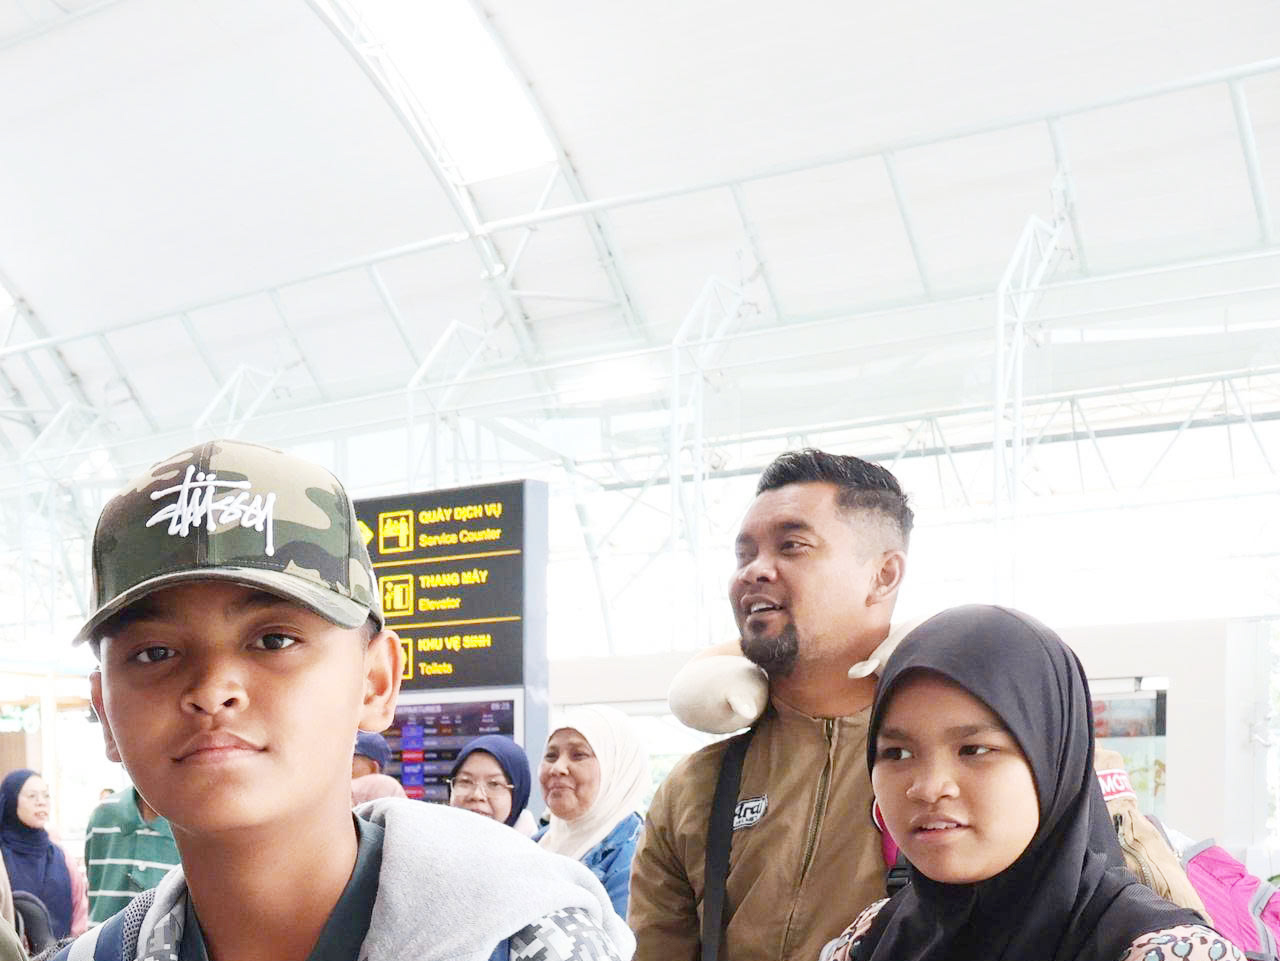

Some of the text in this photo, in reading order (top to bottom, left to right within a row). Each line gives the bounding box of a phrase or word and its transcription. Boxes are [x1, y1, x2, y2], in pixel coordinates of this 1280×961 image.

[418, 528, 502, 547] Service Counter
[418, 572, 460, 589] THANG
[418, 597, 461, 611] Elevator
[418, 637, 443, 652] KHU
[462, 634, 492, 648] SINH
[418, 662, 453, 675] Toilets
